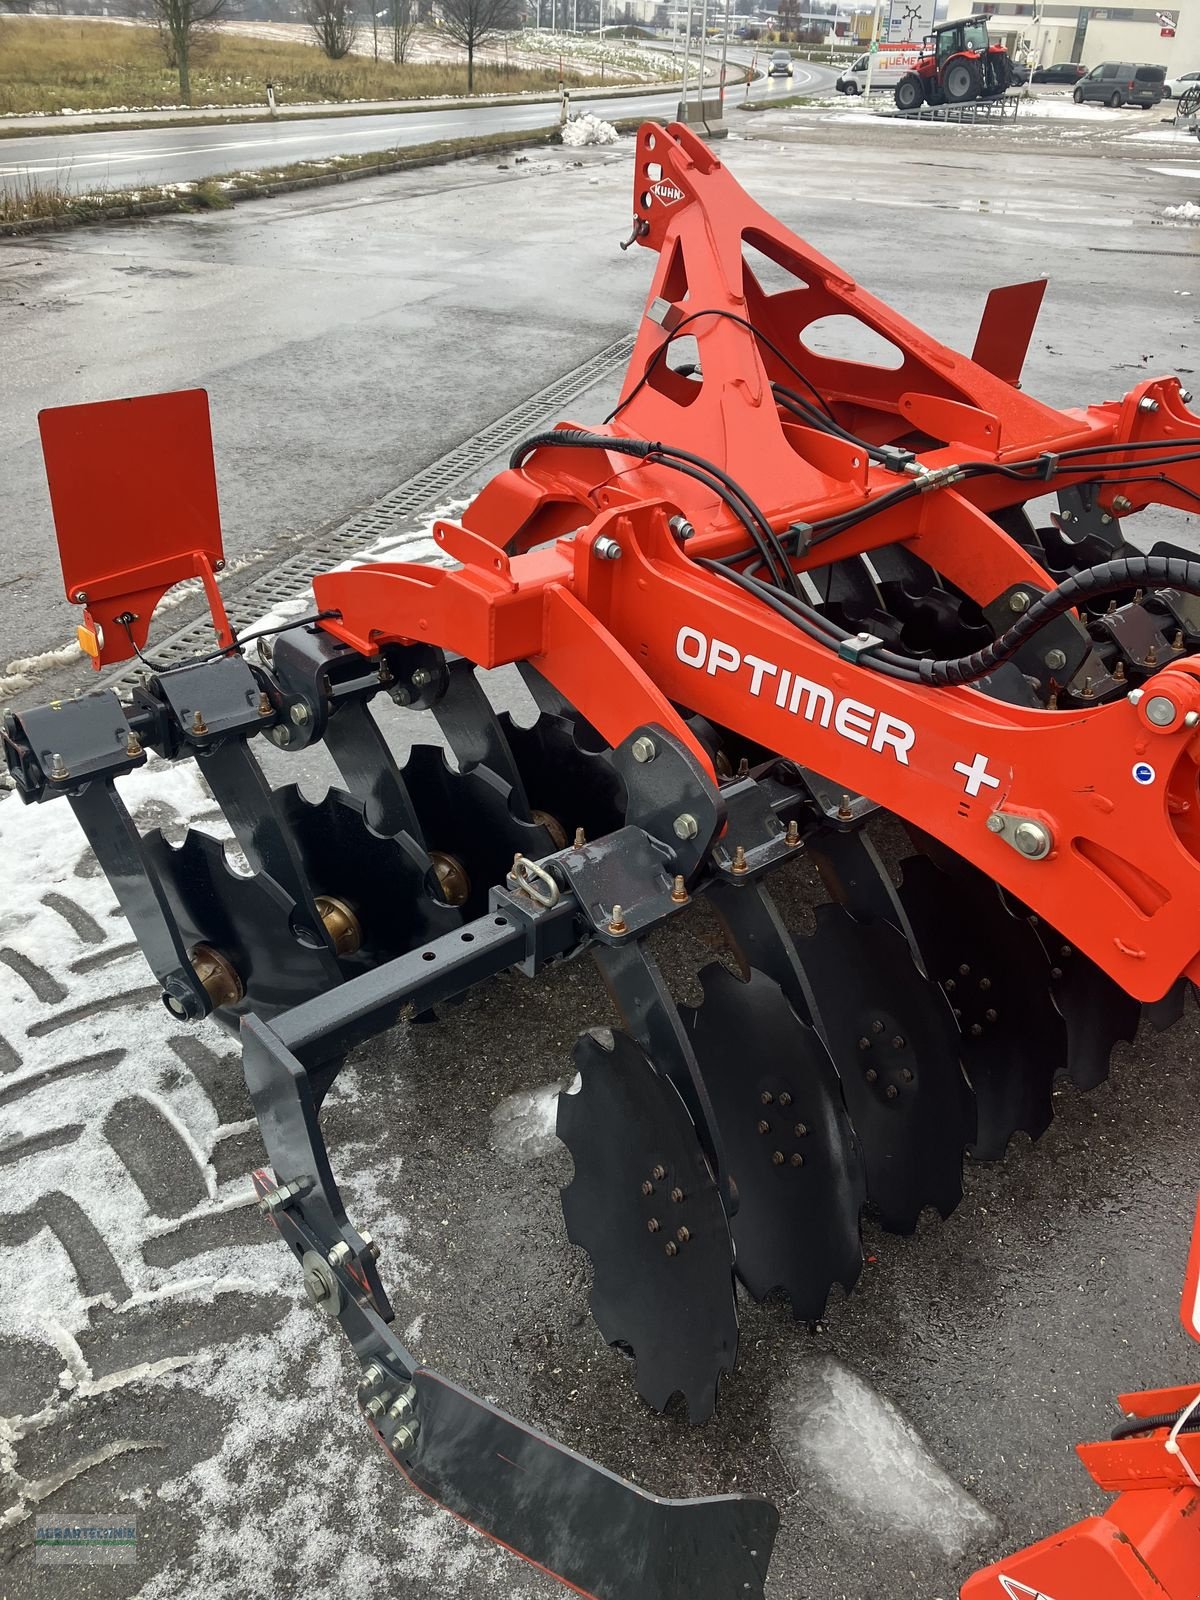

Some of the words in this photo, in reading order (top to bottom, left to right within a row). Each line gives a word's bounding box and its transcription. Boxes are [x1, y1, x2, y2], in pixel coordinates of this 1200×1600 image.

[879, 56, 919, 69] HUEME
[655, 184, 681, 200] KUHN
[676, 625, 917, 766] OPTIMER
